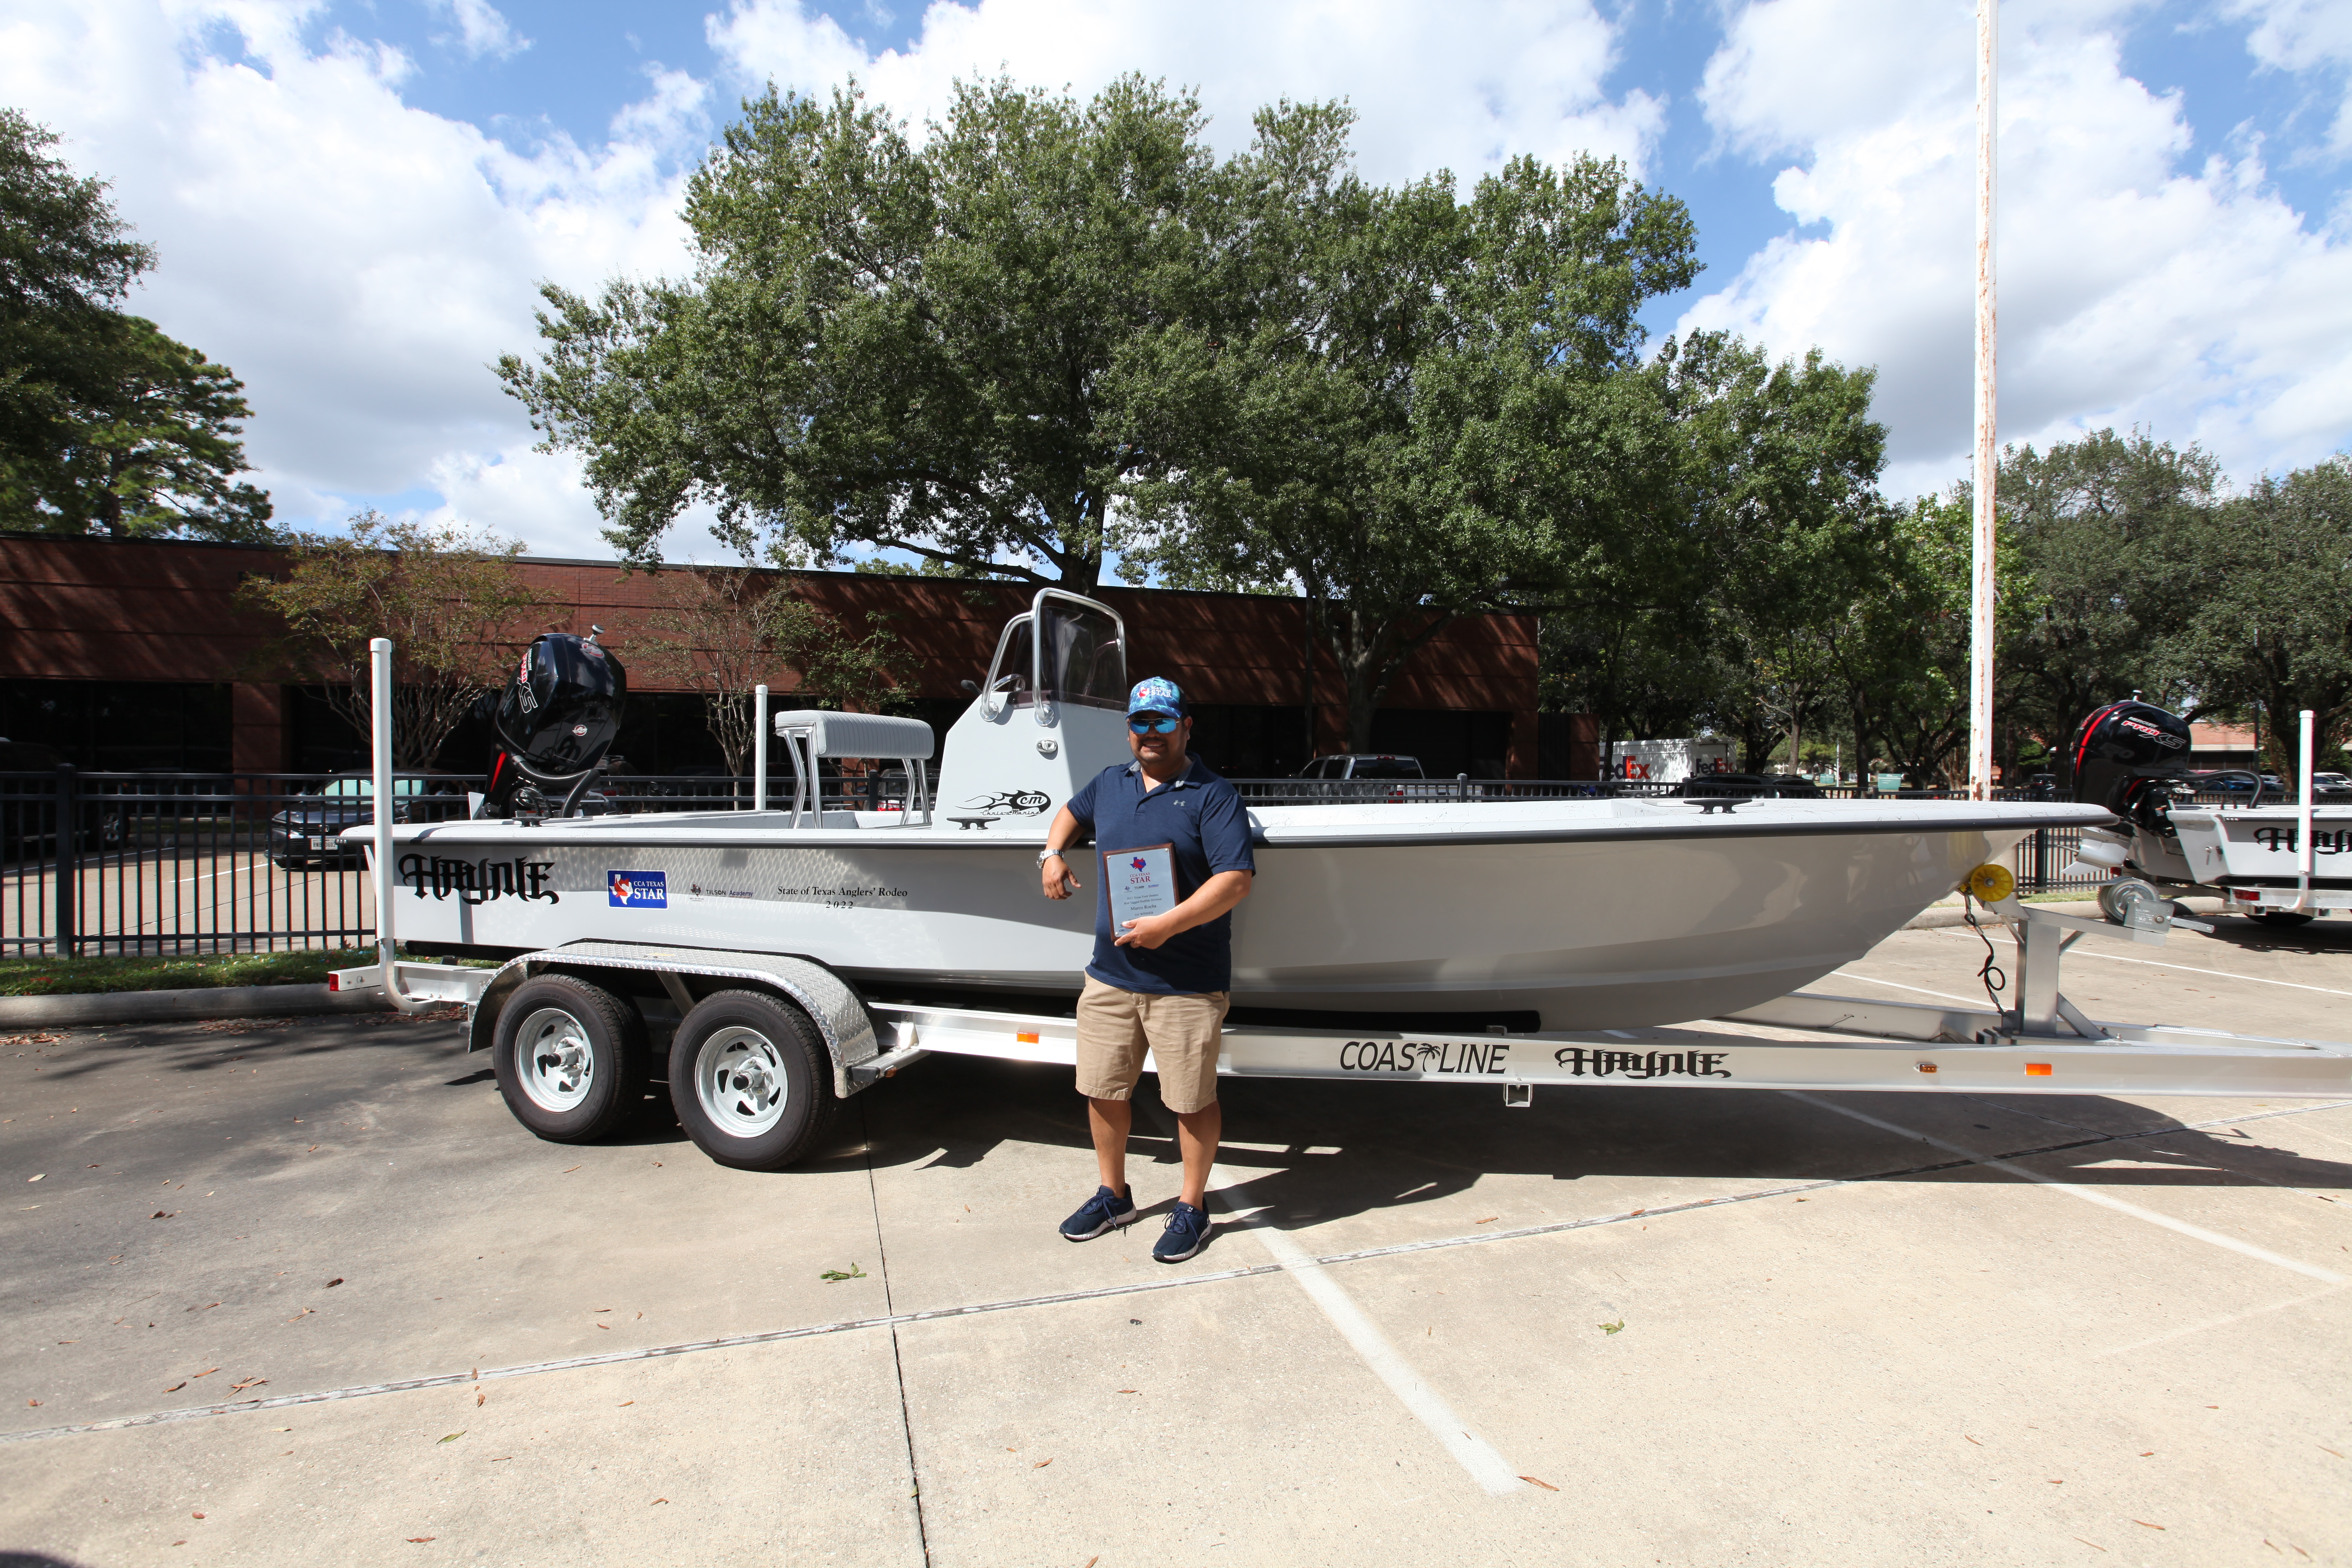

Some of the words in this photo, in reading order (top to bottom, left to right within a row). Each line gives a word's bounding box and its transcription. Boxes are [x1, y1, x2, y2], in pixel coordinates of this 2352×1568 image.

[517, 677, 538, 714] XS
[1151, 689, 1172, 698] STAR
[2128, 717, 2160, 727] MERCURY
[2121, 720, 2161, 736] PRO
[2138, 732, 2187, 749] XS
[1696, 758, 1735, 774] FedEx
[1130, 876, 1151, 884] STAR
[634, 888, 665, 900] STAR
[777, 886, 798, 895] State
[801, 886, 810, 895] of
[812, 887, 836, 895] Texas
[878, 887, 908, 897] Rodeo
[825, 900, 853, 909] 2022
